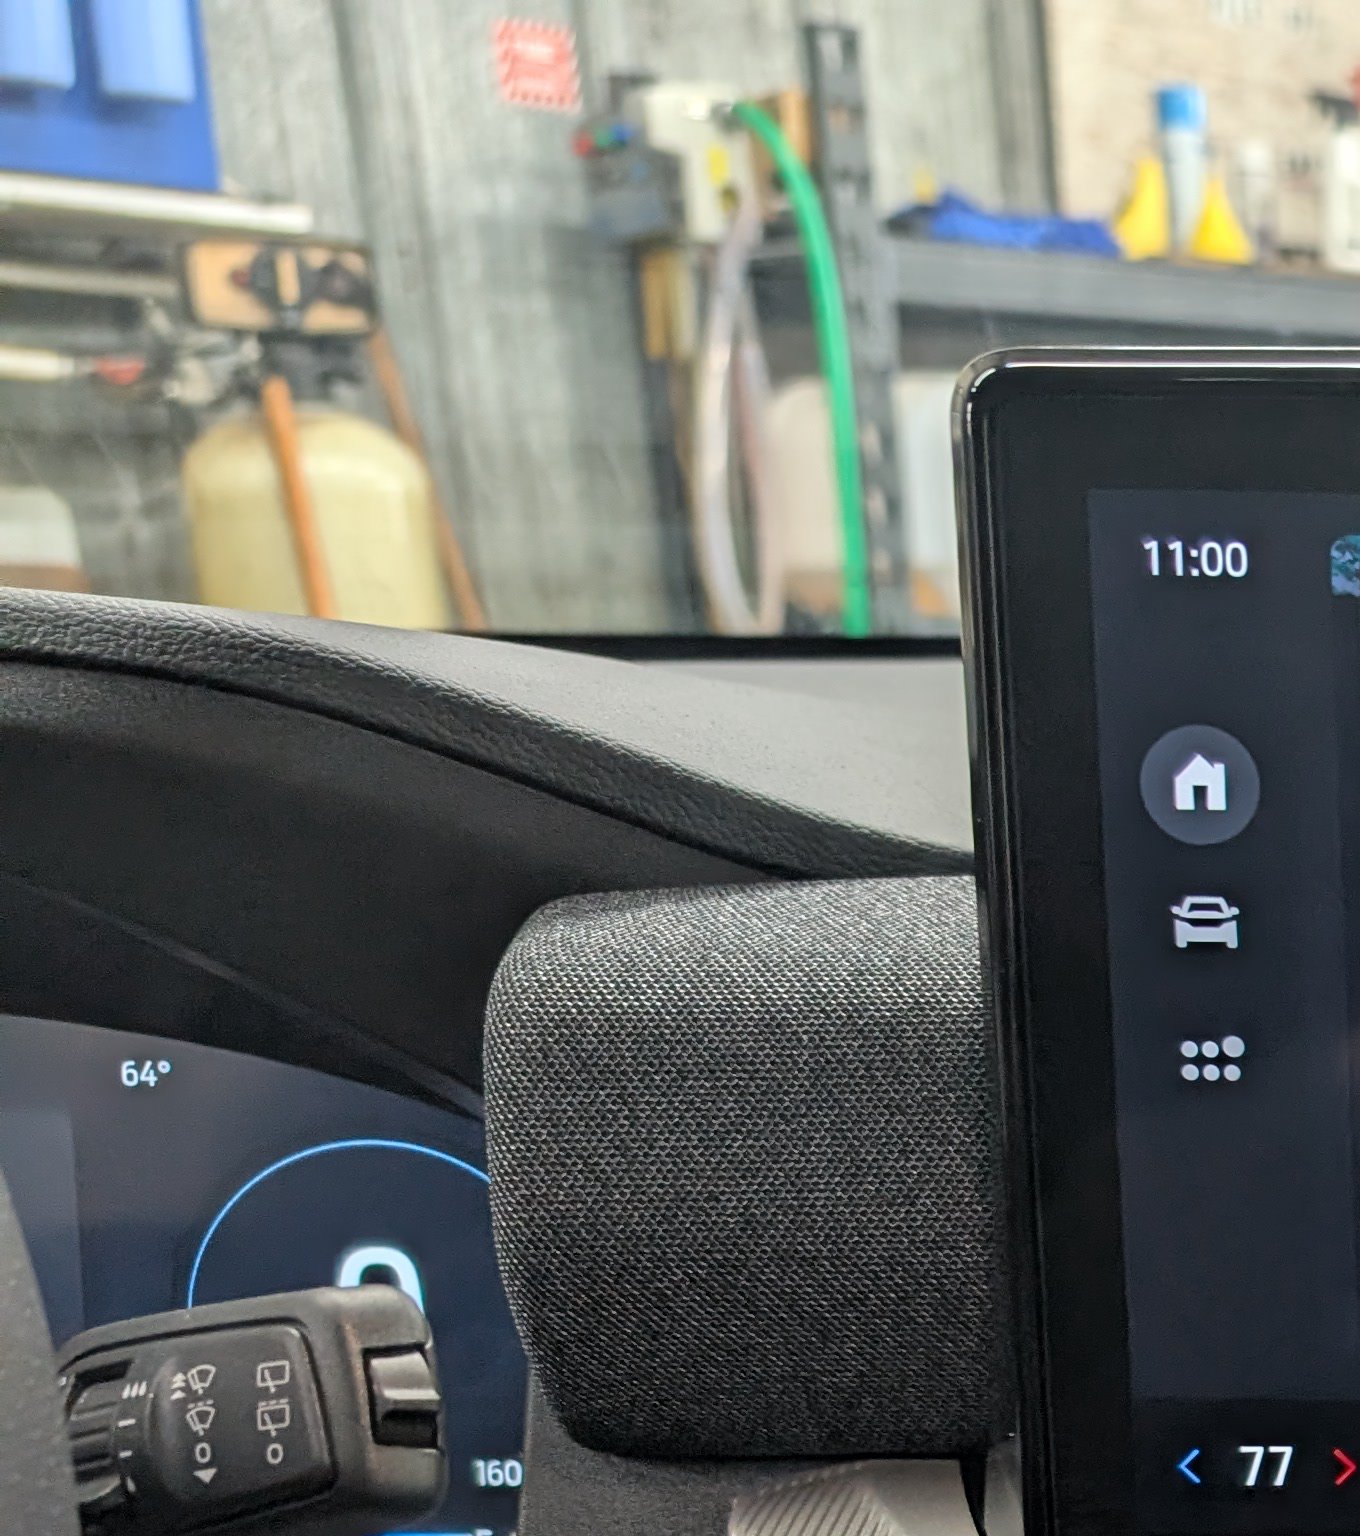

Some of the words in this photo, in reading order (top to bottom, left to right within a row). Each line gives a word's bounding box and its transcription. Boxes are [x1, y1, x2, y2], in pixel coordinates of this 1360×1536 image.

[1144, 538, 1248, 578] 11:00
[473, 1458, 523, 1488] 160
[1238, 1445, 1293, 1487] 77
